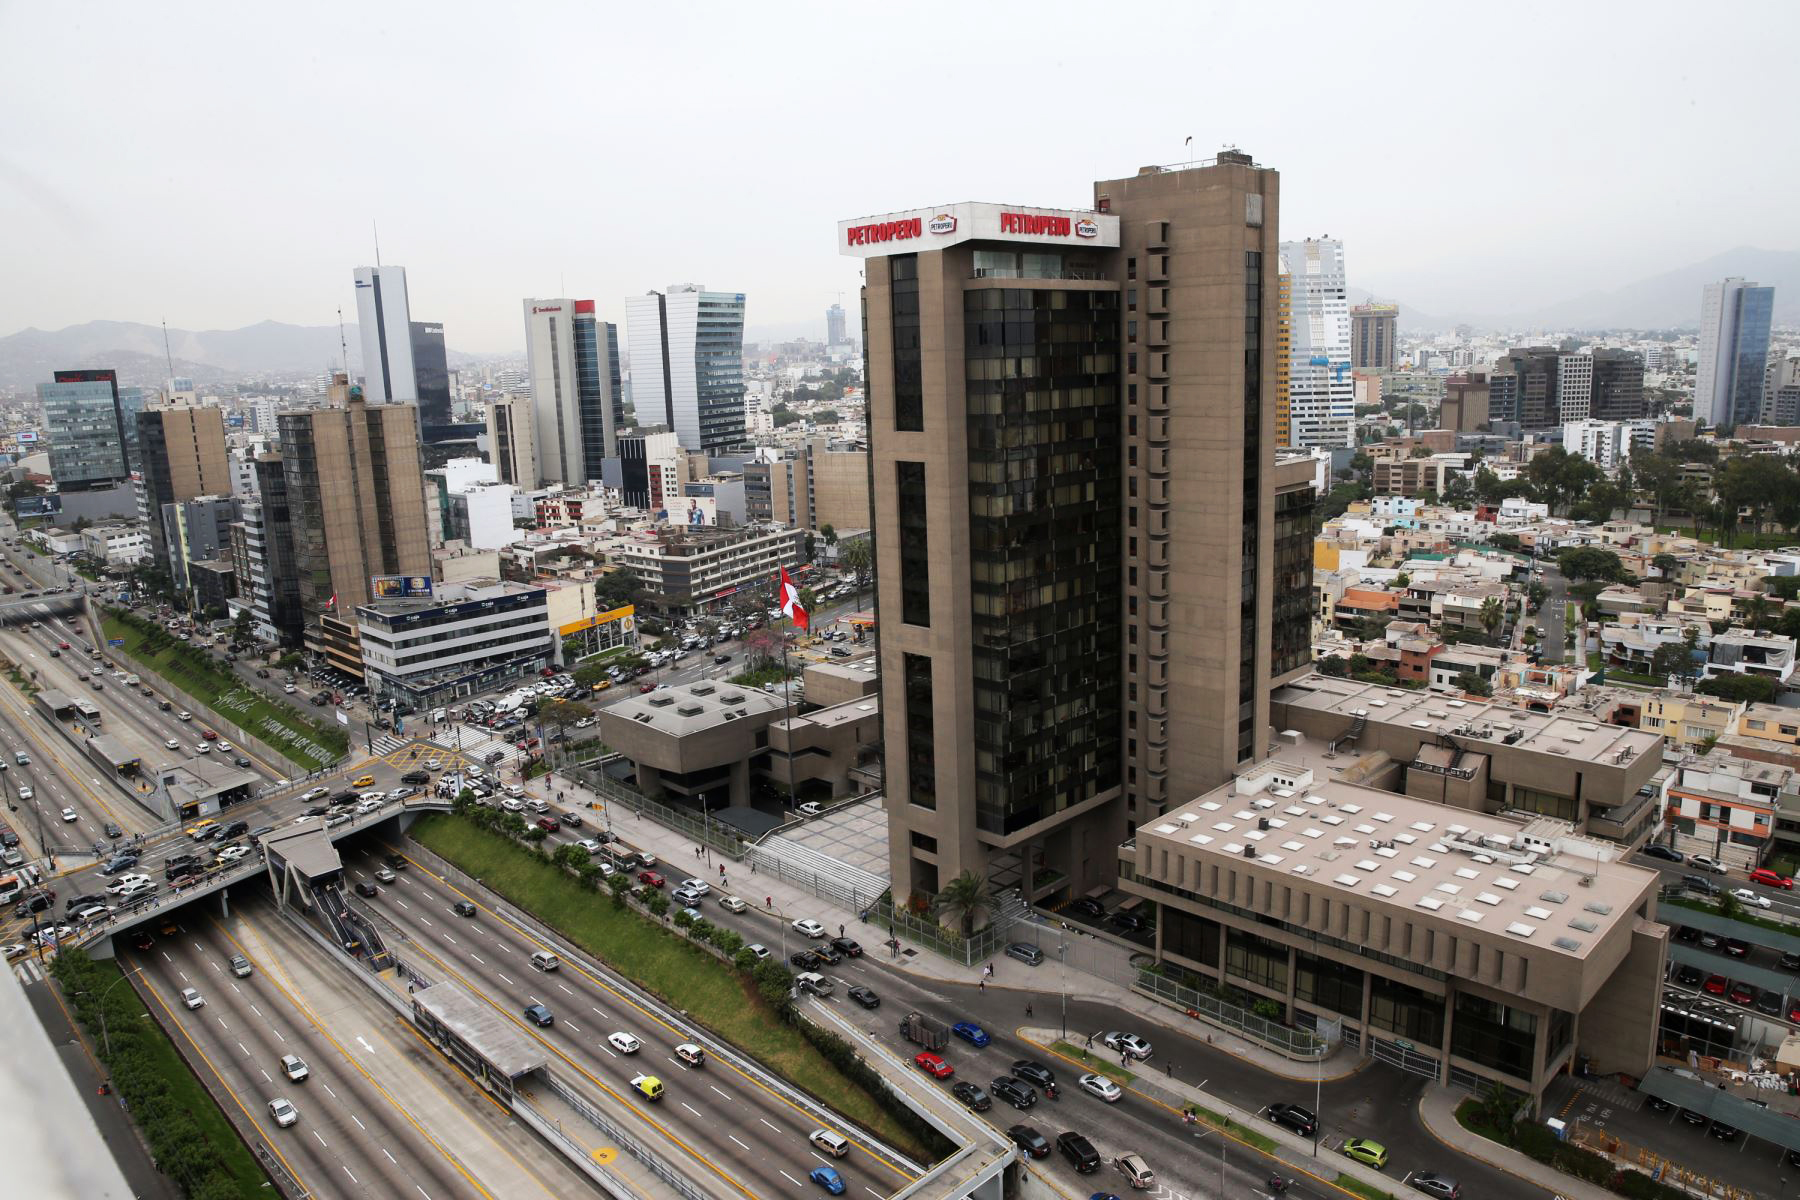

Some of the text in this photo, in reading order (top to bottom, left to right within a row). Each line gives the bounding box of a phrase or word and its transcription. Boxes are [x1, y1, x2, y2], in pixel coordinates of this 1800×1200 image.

[847, 217, 922, 246] PETROPERU
[931, 221, 953, 231] PETROPERU
[1000, 212, 1071, 237] PETROPERU
